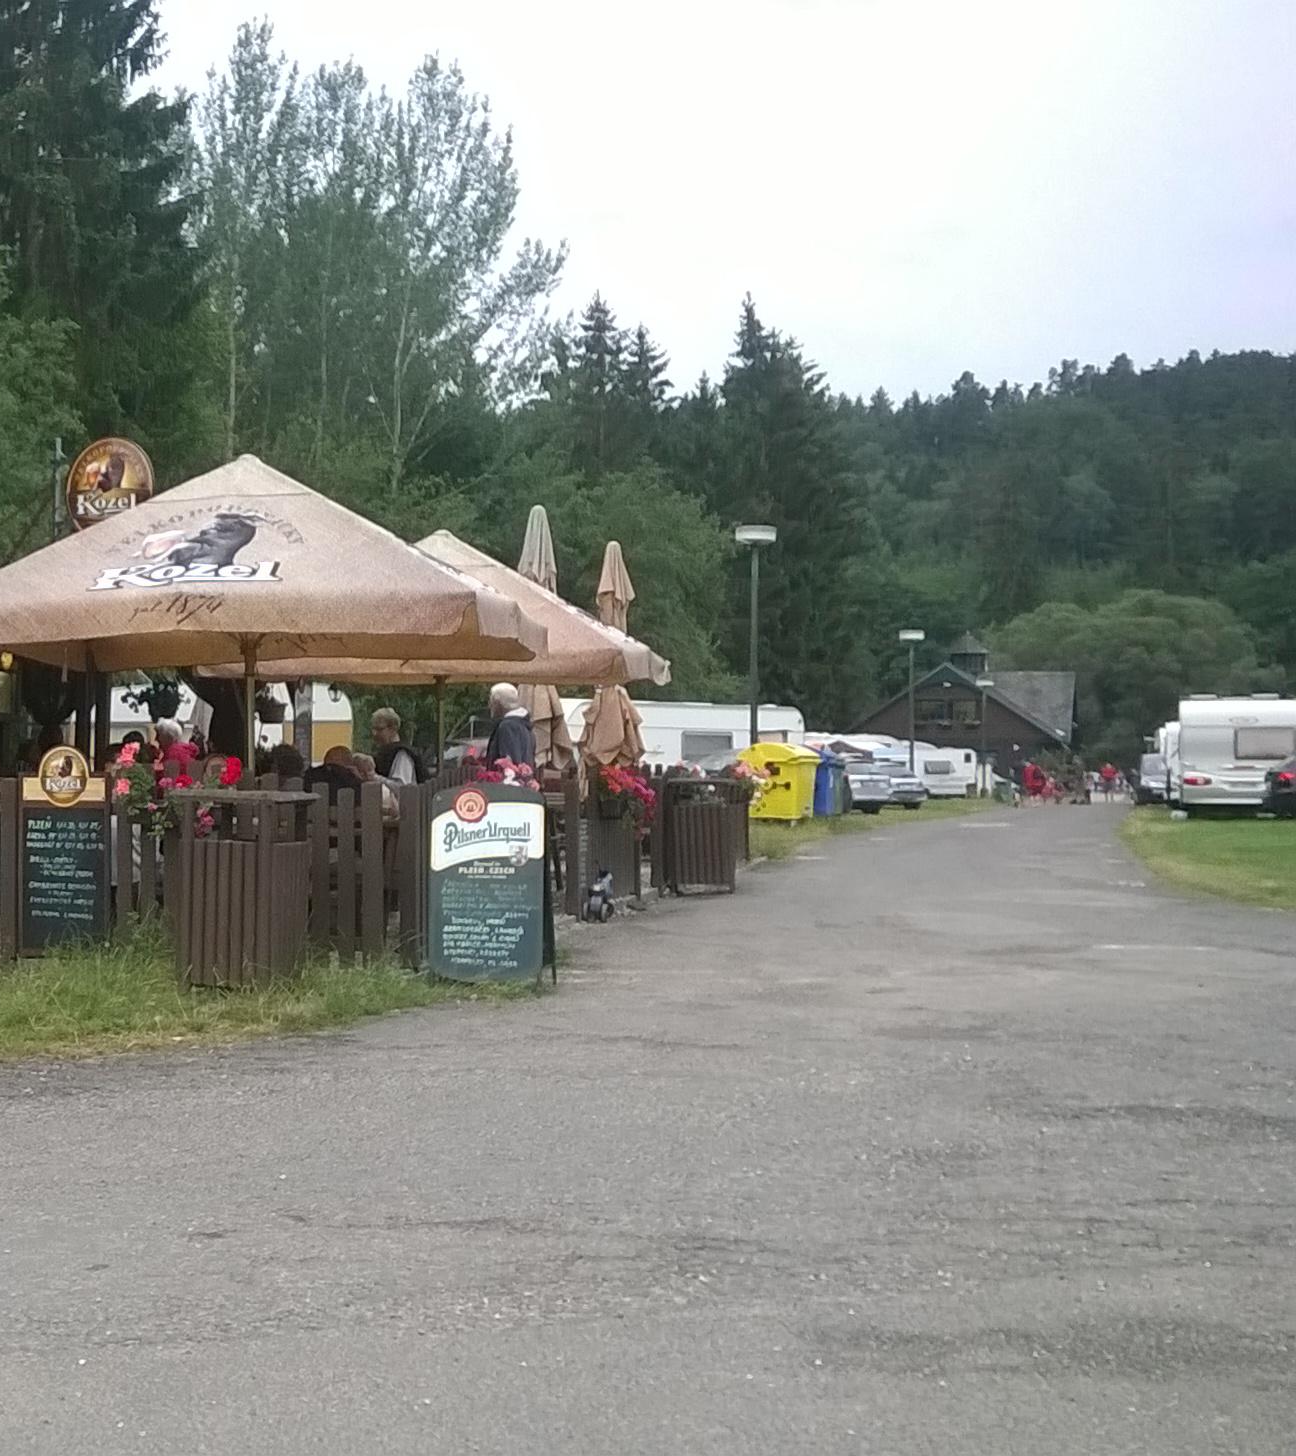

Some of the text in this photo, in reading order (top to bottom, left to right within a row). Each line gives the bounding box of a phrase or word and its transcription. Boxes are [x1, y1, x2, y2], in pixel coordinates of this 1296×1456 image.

[76, 492, 137, 516] Kozel
[86, 560, 284, 592] Kozel
[45, 777, 83, 792] Kozel
[443, 820, 531, 853] Pilsner Urquell
